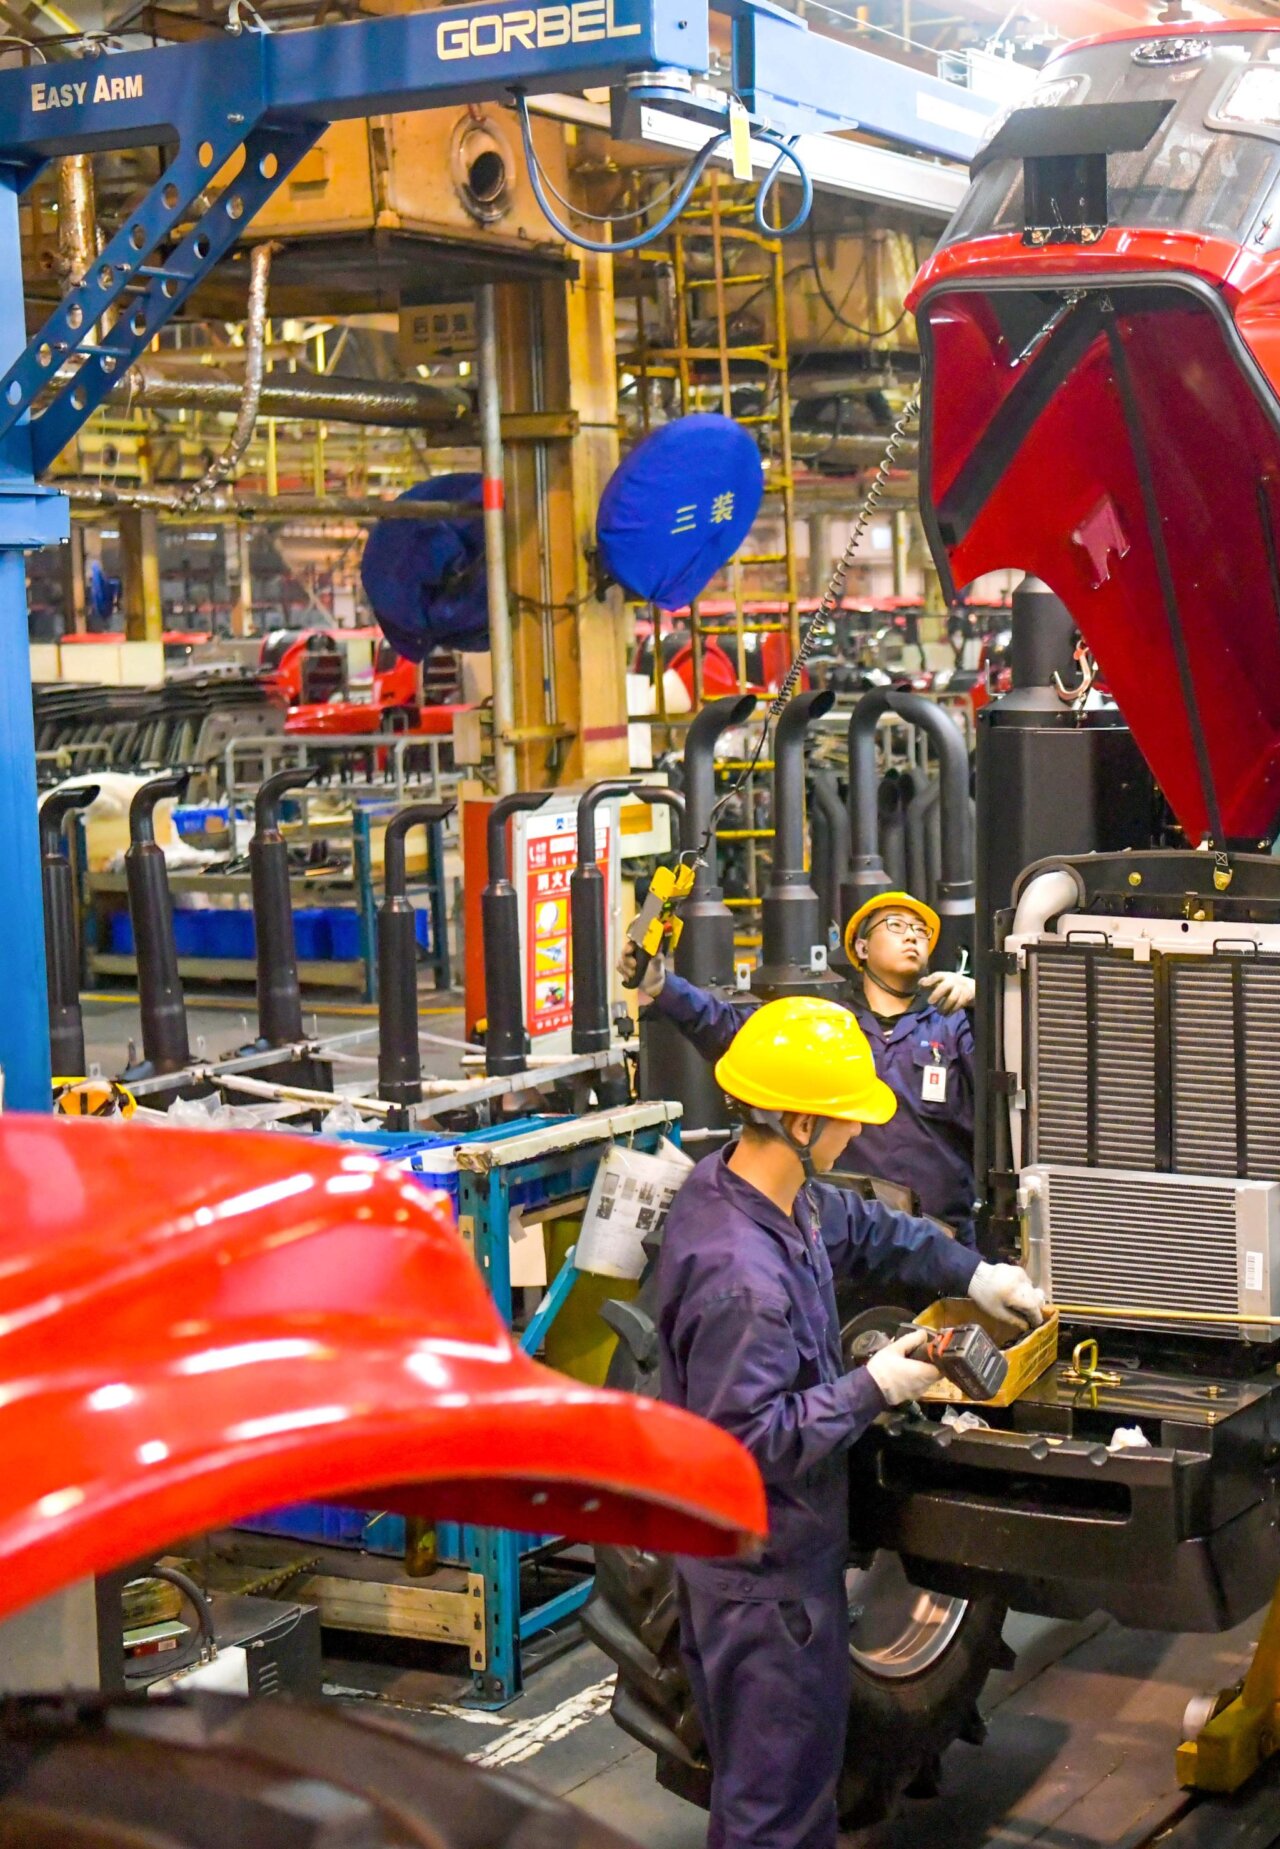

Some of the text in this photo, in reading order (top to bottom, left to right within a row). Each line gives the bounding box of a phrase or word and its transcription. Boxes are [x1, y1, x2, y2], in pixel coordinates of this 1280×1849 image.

[437, 0, 642, 61] GORBEL
[31, 74, 143, 112] EASY ARM
[670, 490, 735, 535] 三装
